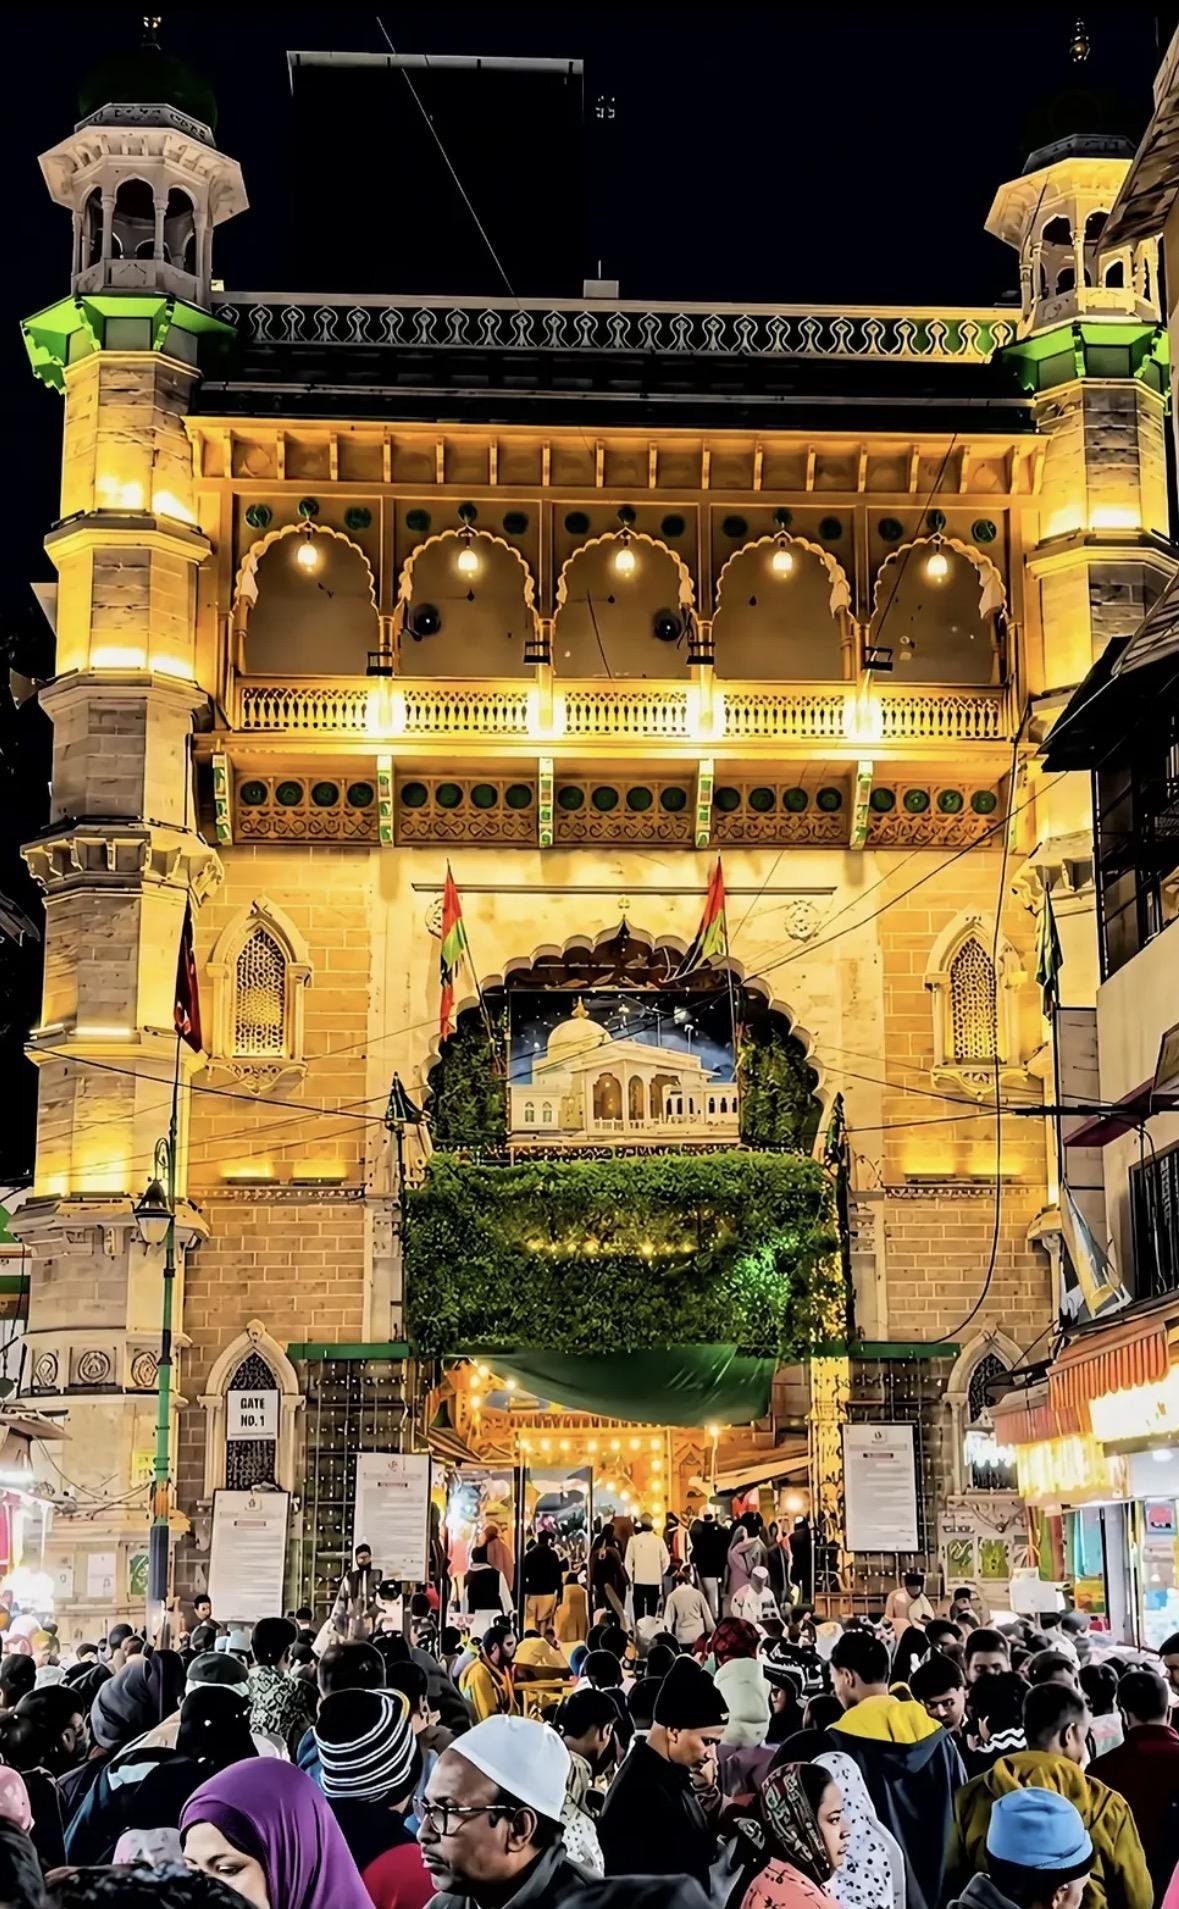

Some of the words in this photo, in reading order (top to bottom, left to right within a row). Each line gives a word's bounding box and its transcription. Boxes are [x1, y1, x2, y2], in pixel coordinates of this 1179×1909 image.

[241, 1398, 264, 1409] GATE
[241, 1415, 257, 1426] NO.
[260, 1415, 264, 1426] 1
